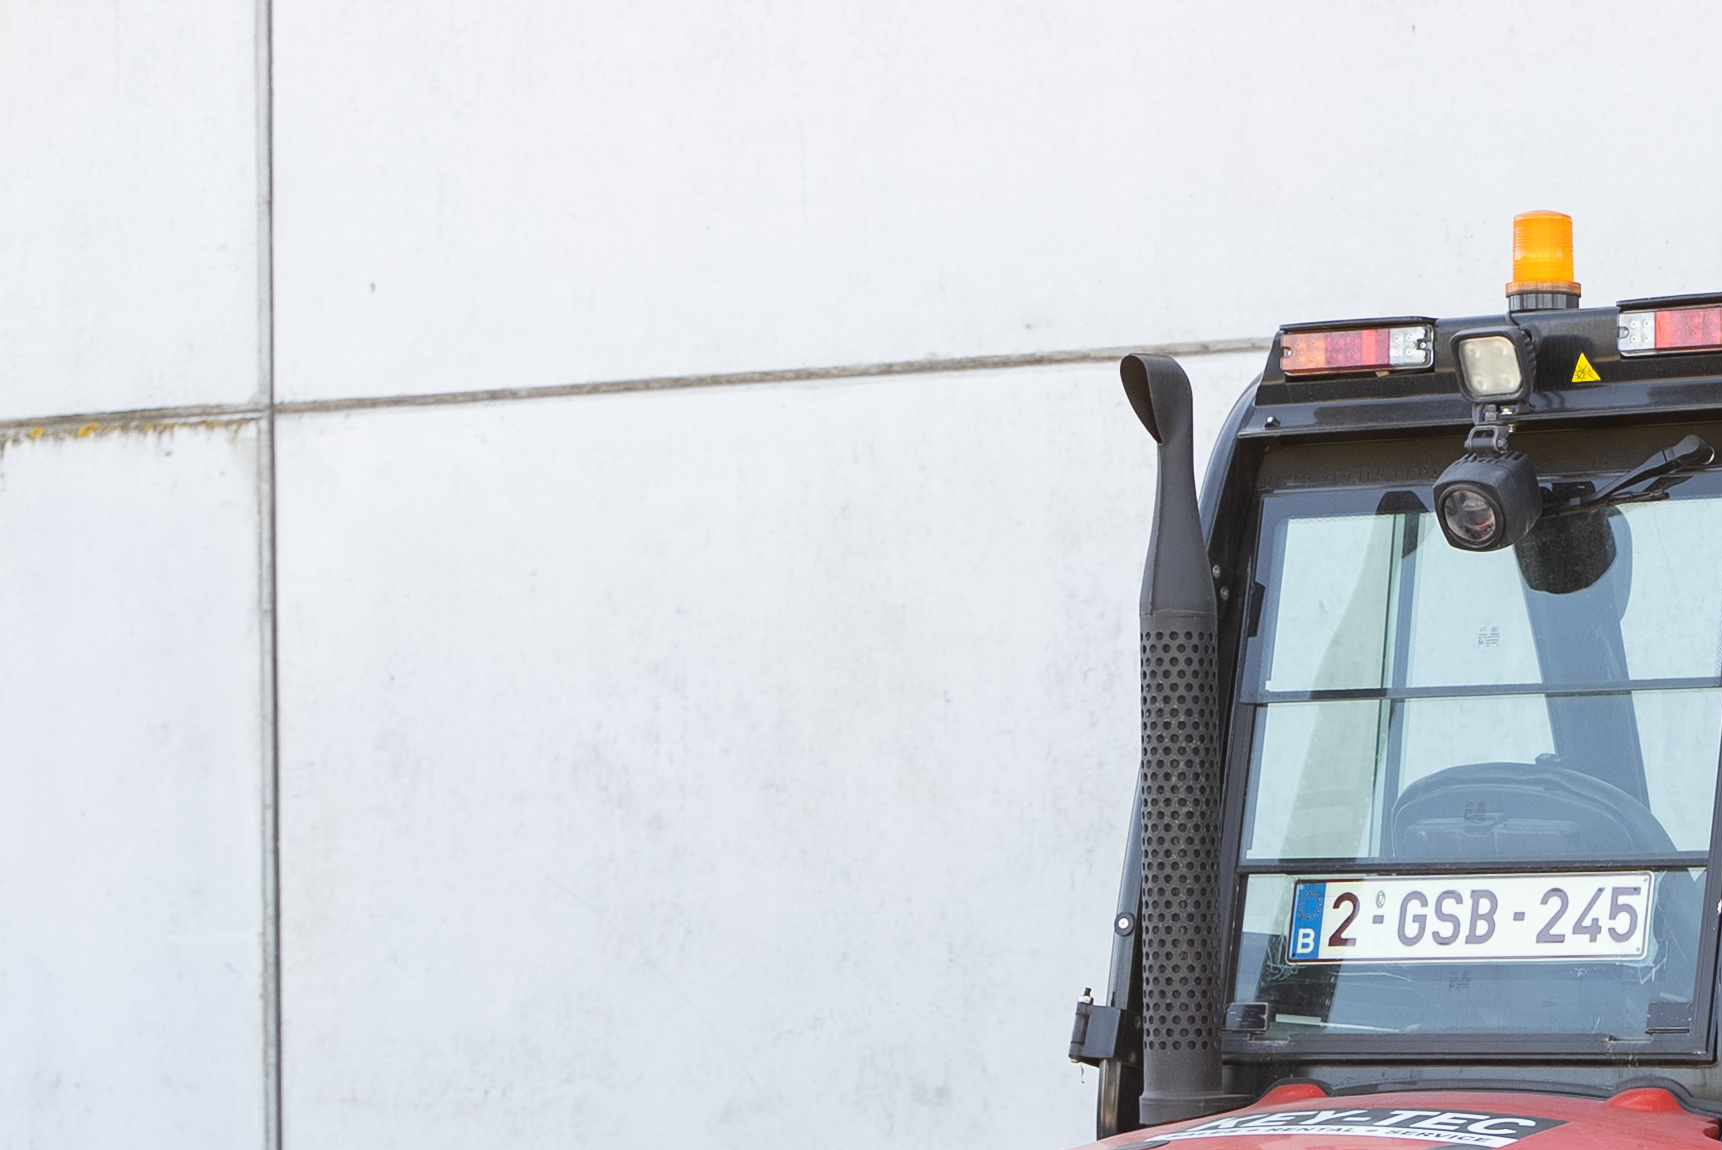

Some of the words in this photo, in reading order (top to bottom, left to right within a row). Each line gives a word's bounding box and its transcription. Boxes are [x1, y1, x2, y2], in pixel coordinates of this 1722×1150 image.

[1296, 928, 1316, 955] B
[1186, 1109, 1537, 1135] KEY-TEC
[1270, 1126, 1355, 1134] RENTAL
[1384, 1128, 1493, 1144] SERVICE
